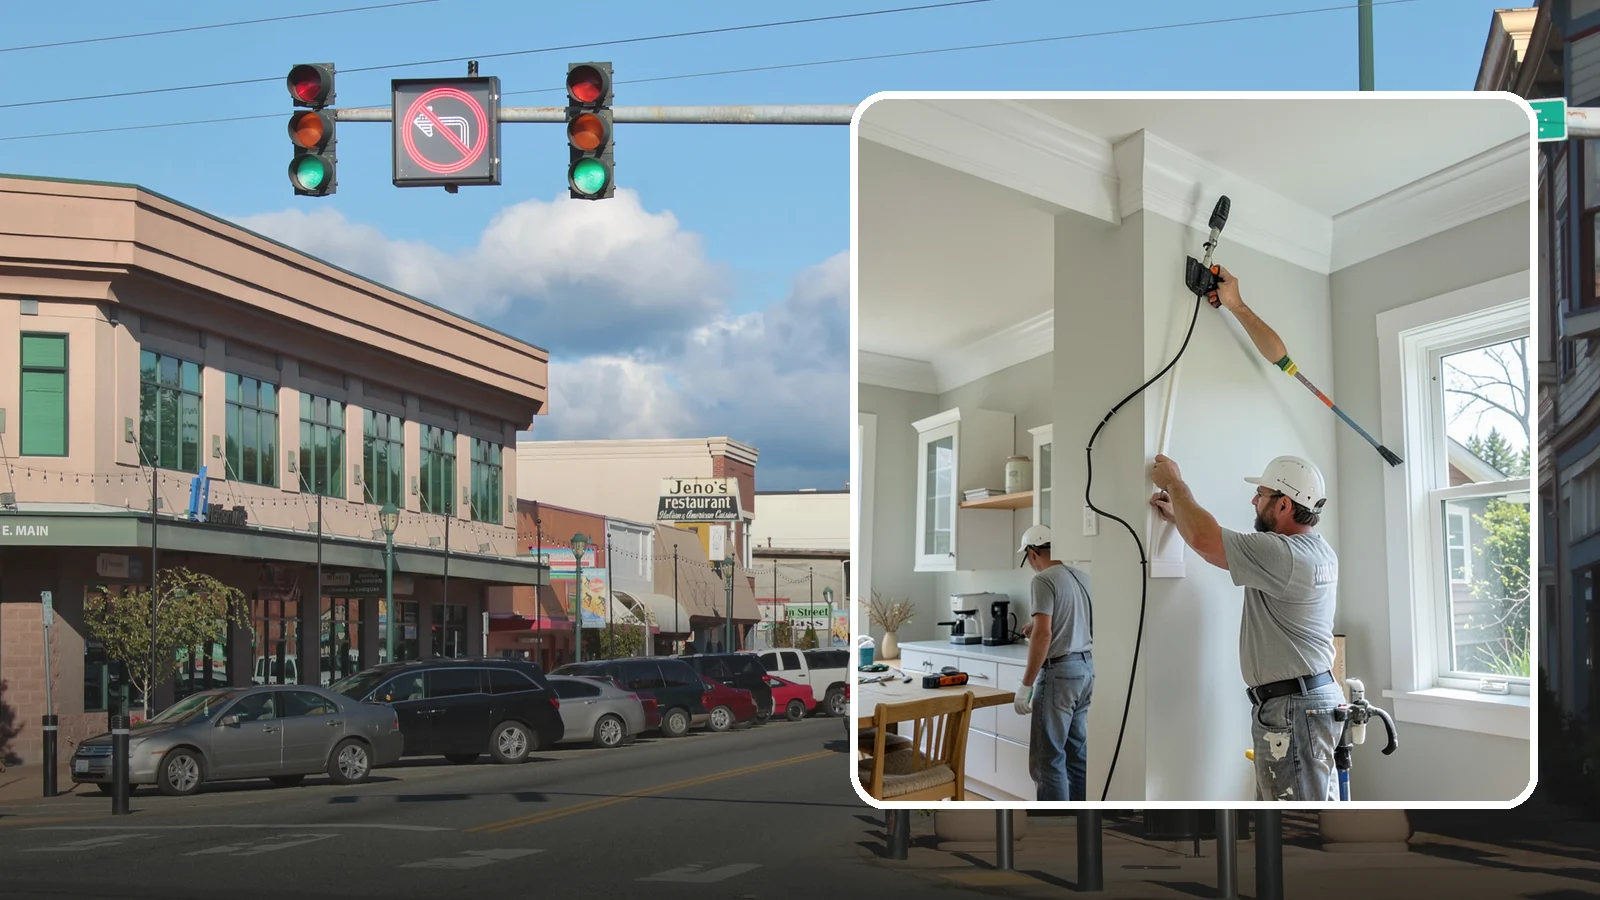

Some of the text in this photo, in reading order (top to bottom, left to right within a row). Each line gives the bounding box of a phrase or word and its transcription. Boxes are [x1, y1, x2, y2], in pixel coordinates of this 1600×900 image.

[670, 480, 728, 494] Jeno's
[665, 496, 730, 509] restaurant
[659, 510, 682, 520] Italian
[686, 510, 714, 519] American
[715, 510, 738, 519] Cuisine
[2, 525, 49, 536] E. MAIN
[798, 608, 828, 616] Street
